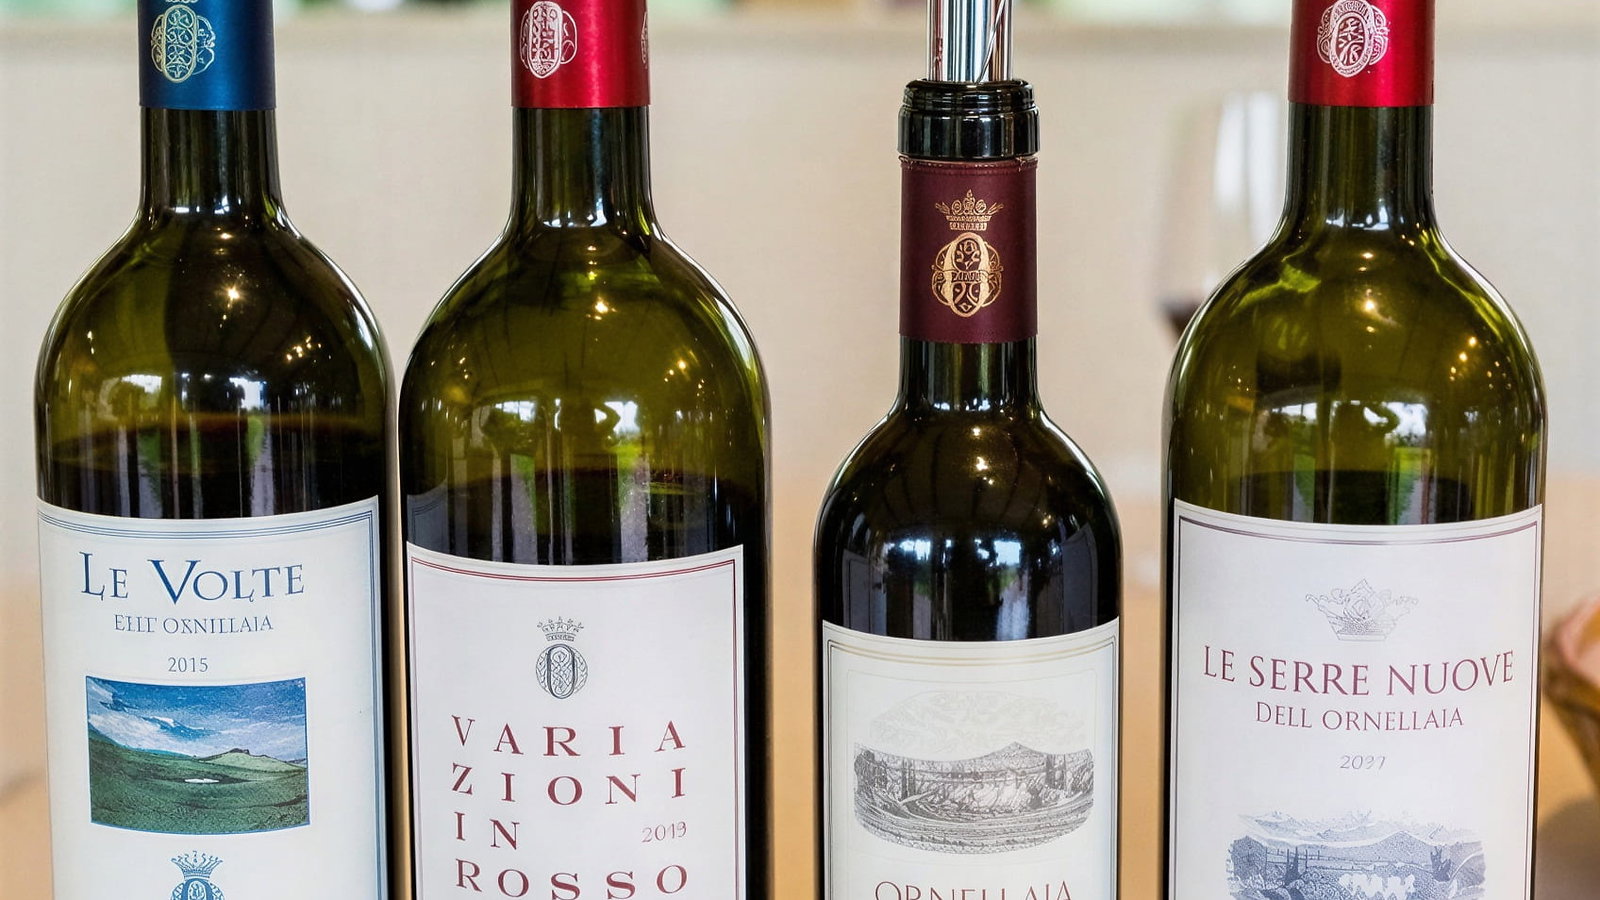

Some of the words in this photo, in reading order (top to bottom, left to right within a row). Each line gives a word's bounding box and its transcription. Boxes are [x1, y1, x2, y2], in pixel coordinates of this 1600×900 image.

[79, 551, 128, 602] LE
[147, 558, 305, 605] VOLTE
[168, 656, 209, 673] 2015
[1203, 645, 1236, 682] LE
[1249, 655, 1370, 696] SERRE
[1386, 650, 1514, 696] NUOVE
[451, 714, 686, 757] VARIA
[1256, 701, 1313, 729] DELL
[1322, 707, 1464, 732] ORNELLAIA
[452, 762, 687, 806] ZIONI
[454, 811, 520, 850] IN
[455, 858, 688, 900] ROSSO
